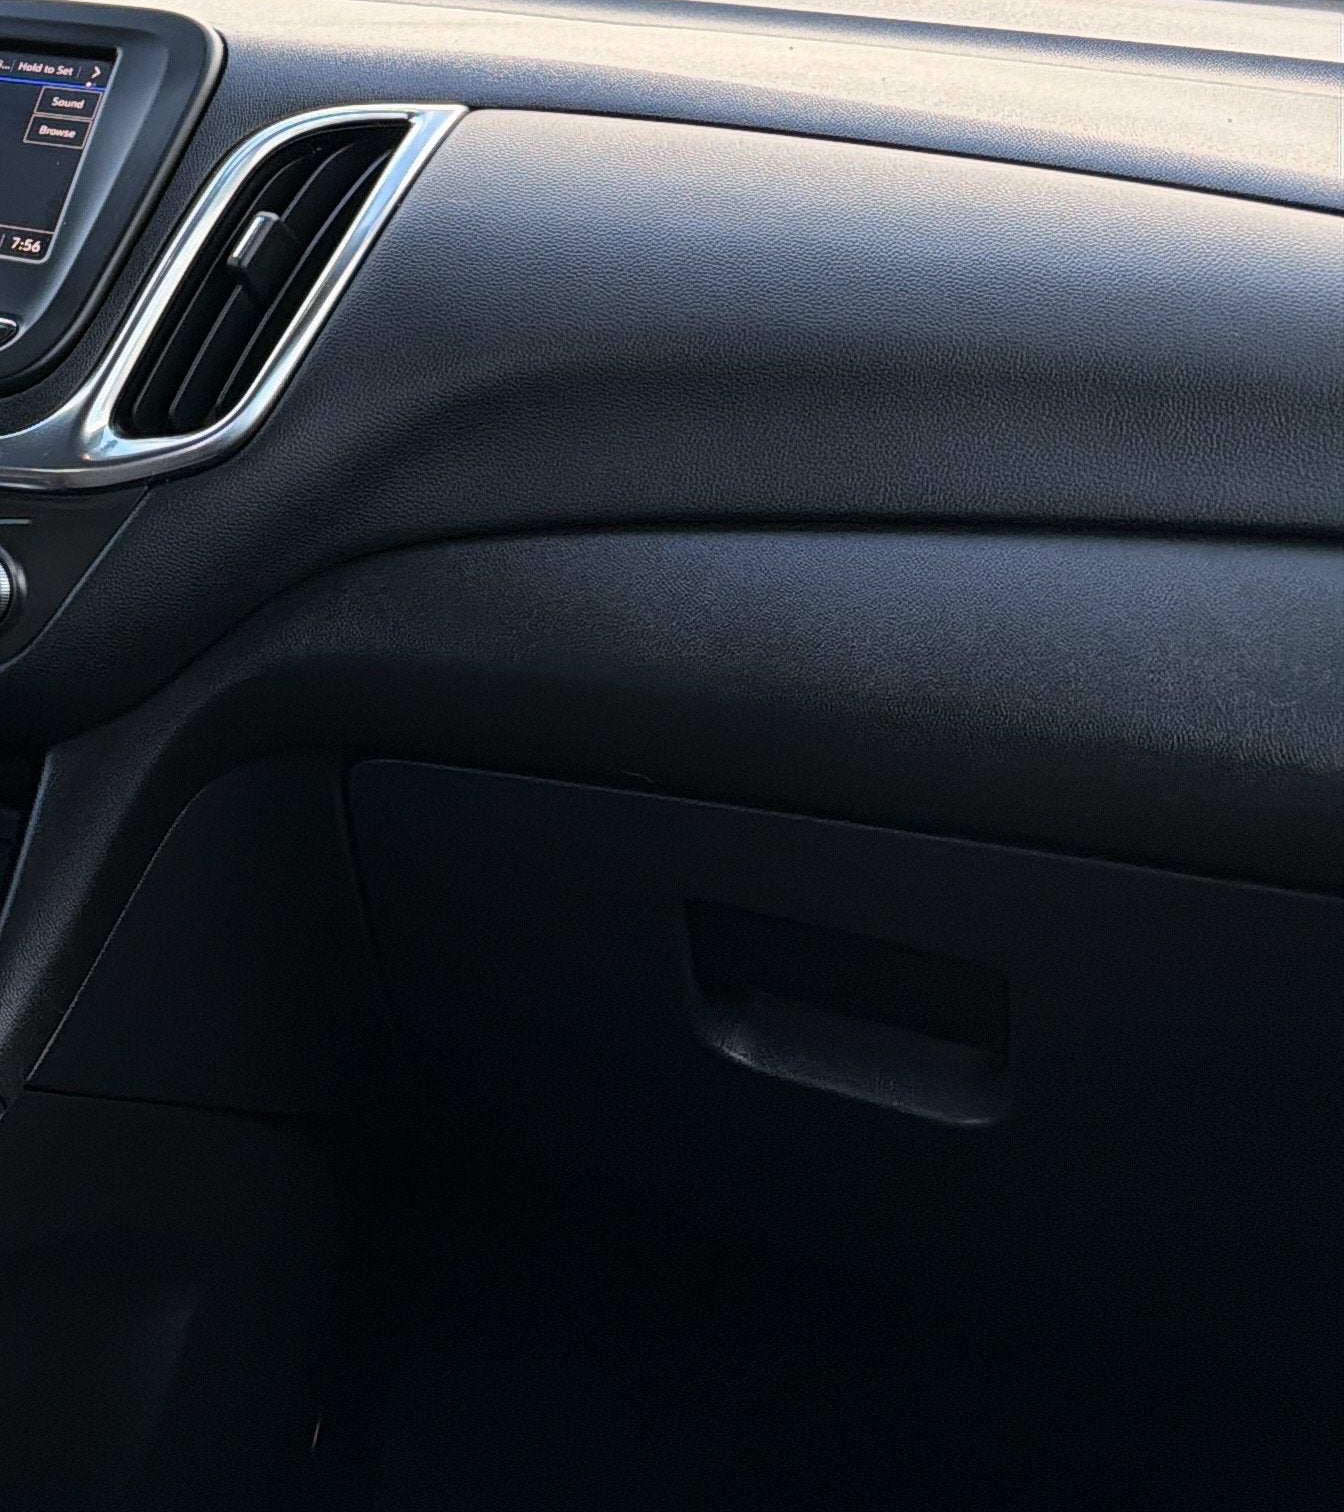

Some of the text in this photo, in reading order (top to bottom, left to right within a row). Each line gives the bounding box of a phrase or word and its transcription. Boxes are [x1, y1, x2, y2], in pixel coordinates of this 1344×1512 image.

[18, 62, 73, 76] Hold to Set
[51, 96, 86, 109] Sound
[38, 125, 76, 139] Browse
[11, 237, 42, 253] 7:56
